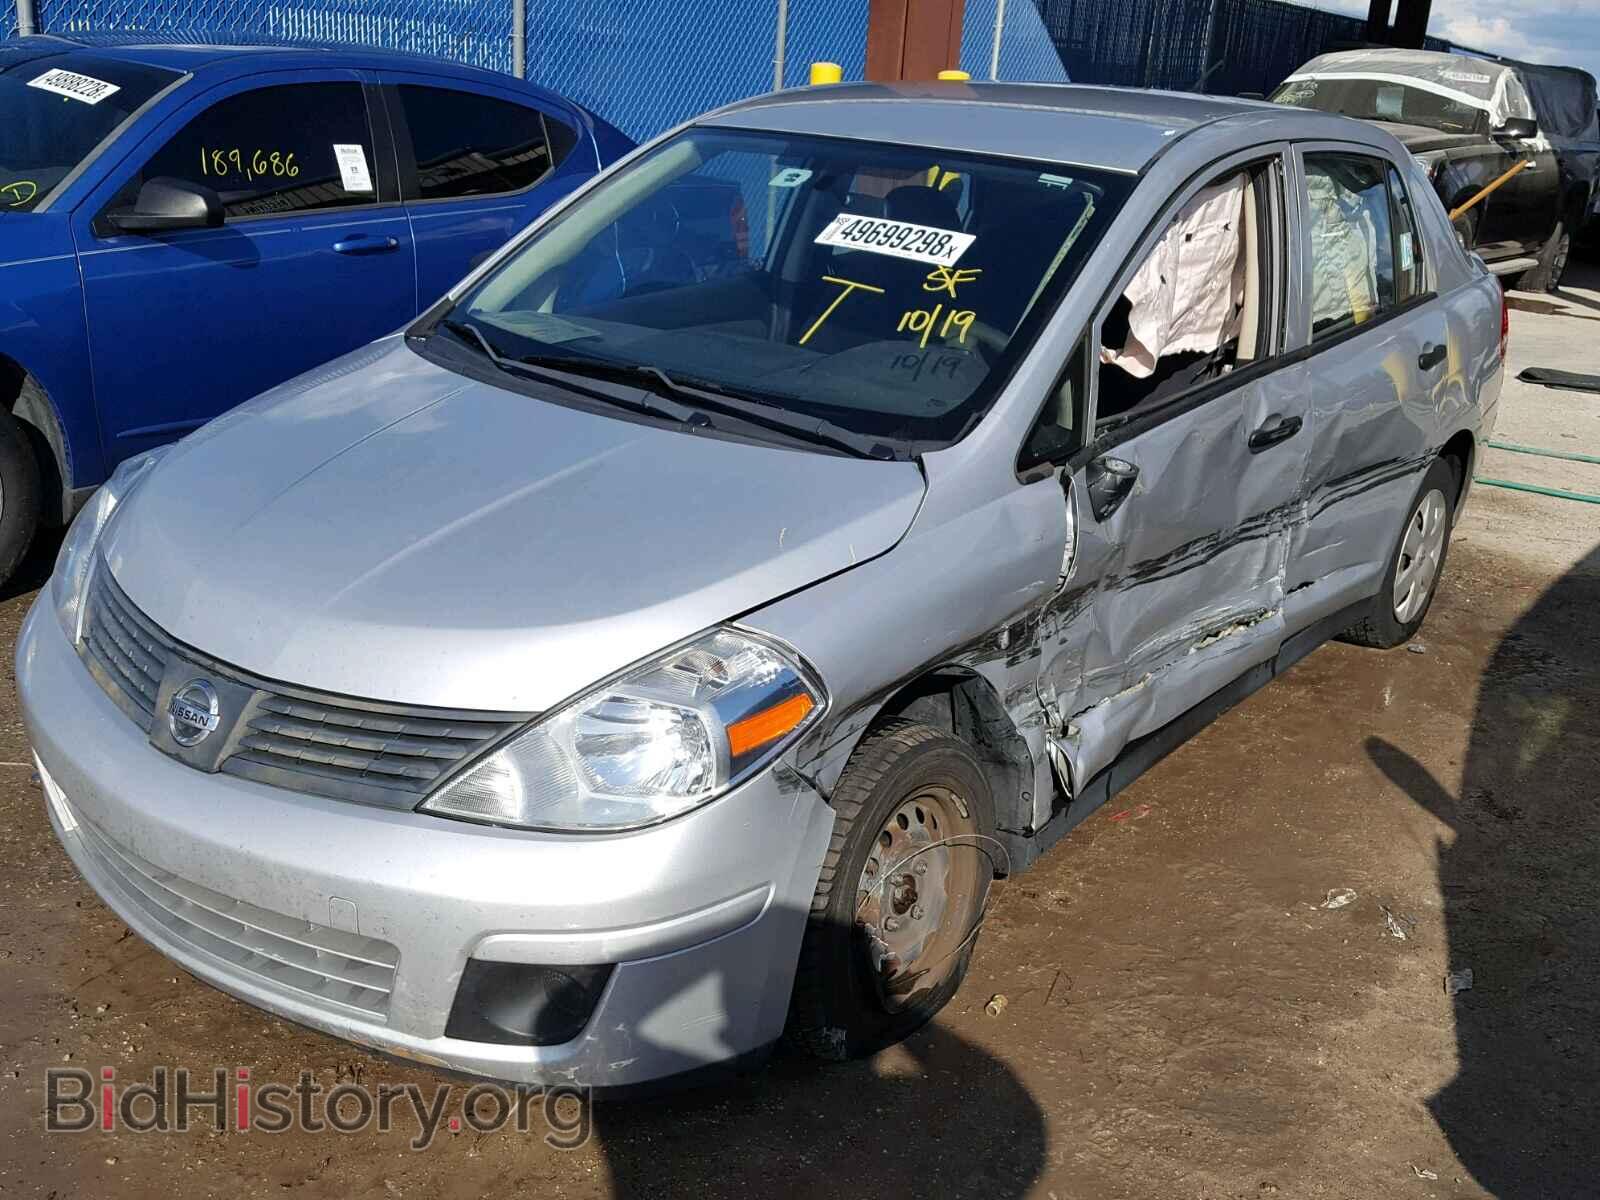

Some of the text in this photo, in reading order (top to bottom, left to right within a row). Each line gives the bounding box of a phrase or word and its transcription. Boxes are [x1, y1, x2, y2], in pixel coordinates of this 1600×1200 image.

[202, 147, 298, 182] 189,686
[799, 275, 885, 344] T
[897, 303, 976, 349] 10/19
[170, 702, 209, 727] NISSAN
